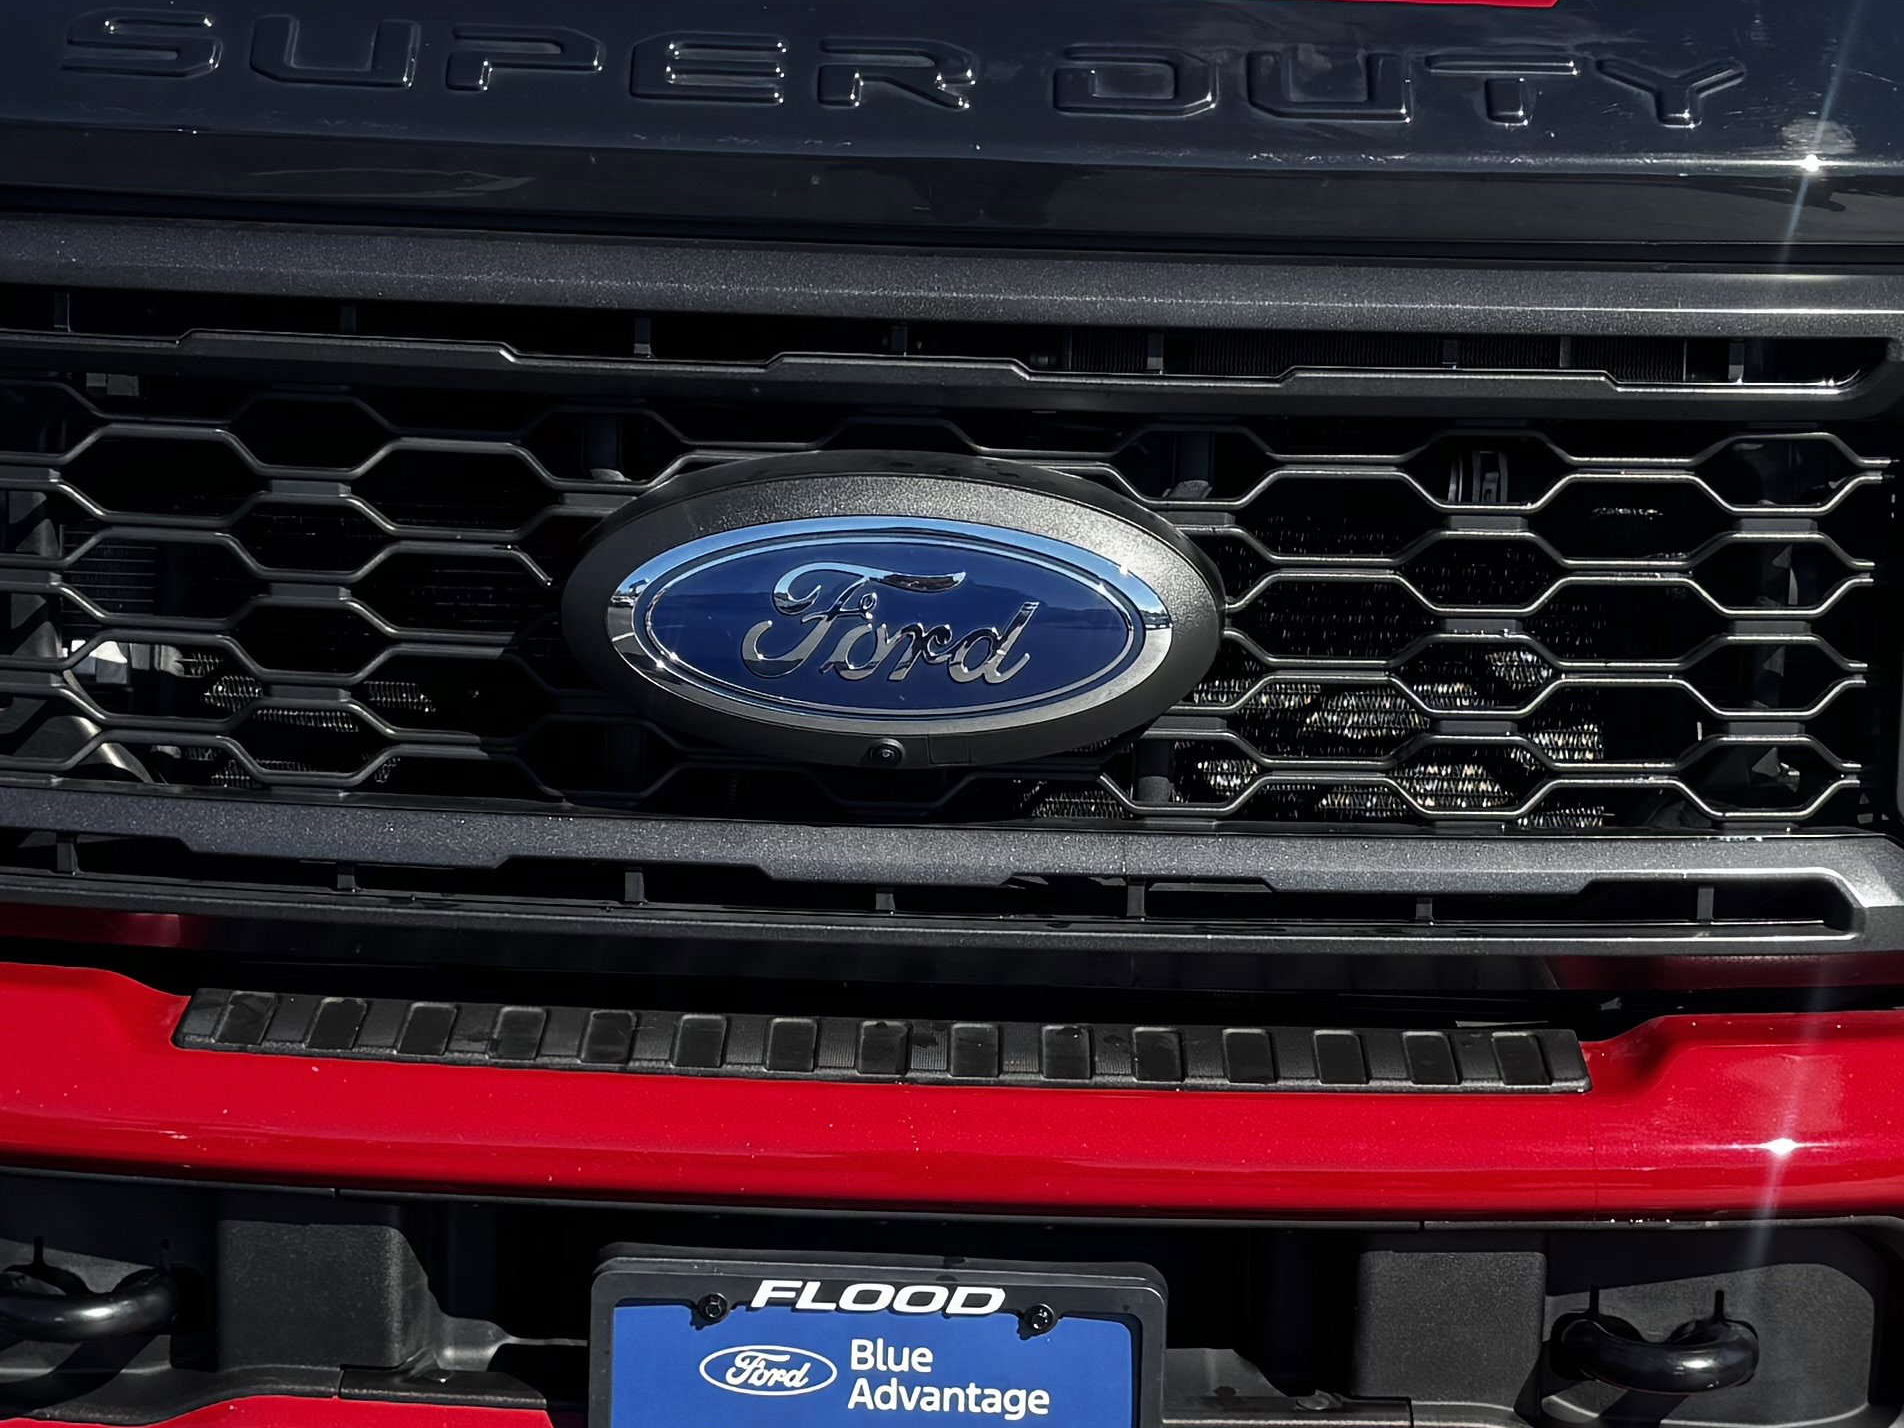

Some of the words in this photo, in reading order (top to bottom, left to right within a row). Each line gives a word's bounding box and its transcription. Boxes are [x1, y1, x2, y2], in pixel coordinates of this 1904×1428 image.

[60, 10, 980, 112] SUPER
[1052, 42, 1747, 130] DUTY
[741, 561, 1039, 684] Ford
[751, 1279, 1006, 1315] FLOOD
[725, 1350, 811, 1389] Ford
[850, 1337, 934, 1373] Blue
[847, 1377, 1051, 1421] Advantage
